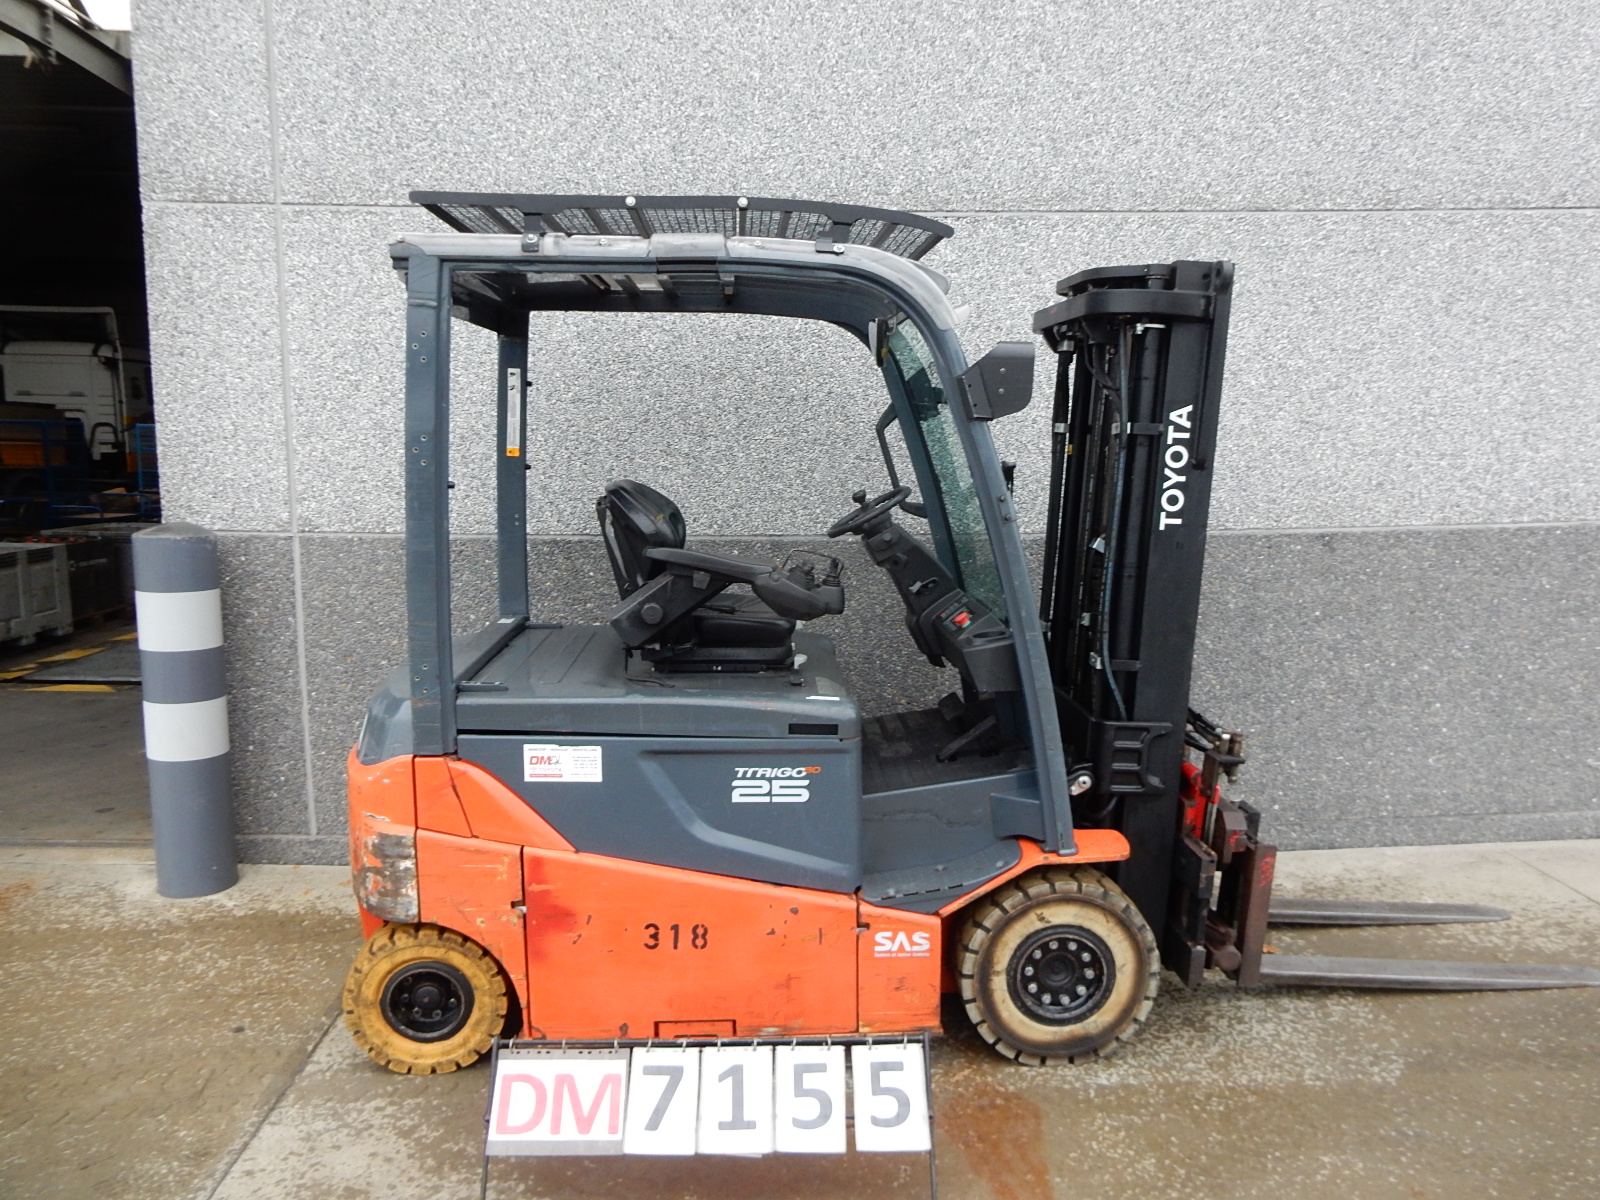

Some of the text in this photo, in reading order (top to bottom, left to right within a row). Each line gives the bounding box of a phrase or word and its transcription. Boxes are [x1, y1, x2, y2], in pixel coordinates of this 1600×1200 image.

[1159, 404, 1193, 530] TOYOTA
[731, 779, 810, 803] 25
[643, 923, 708, 950] 318
[874, 931, 930, 952] SAS
